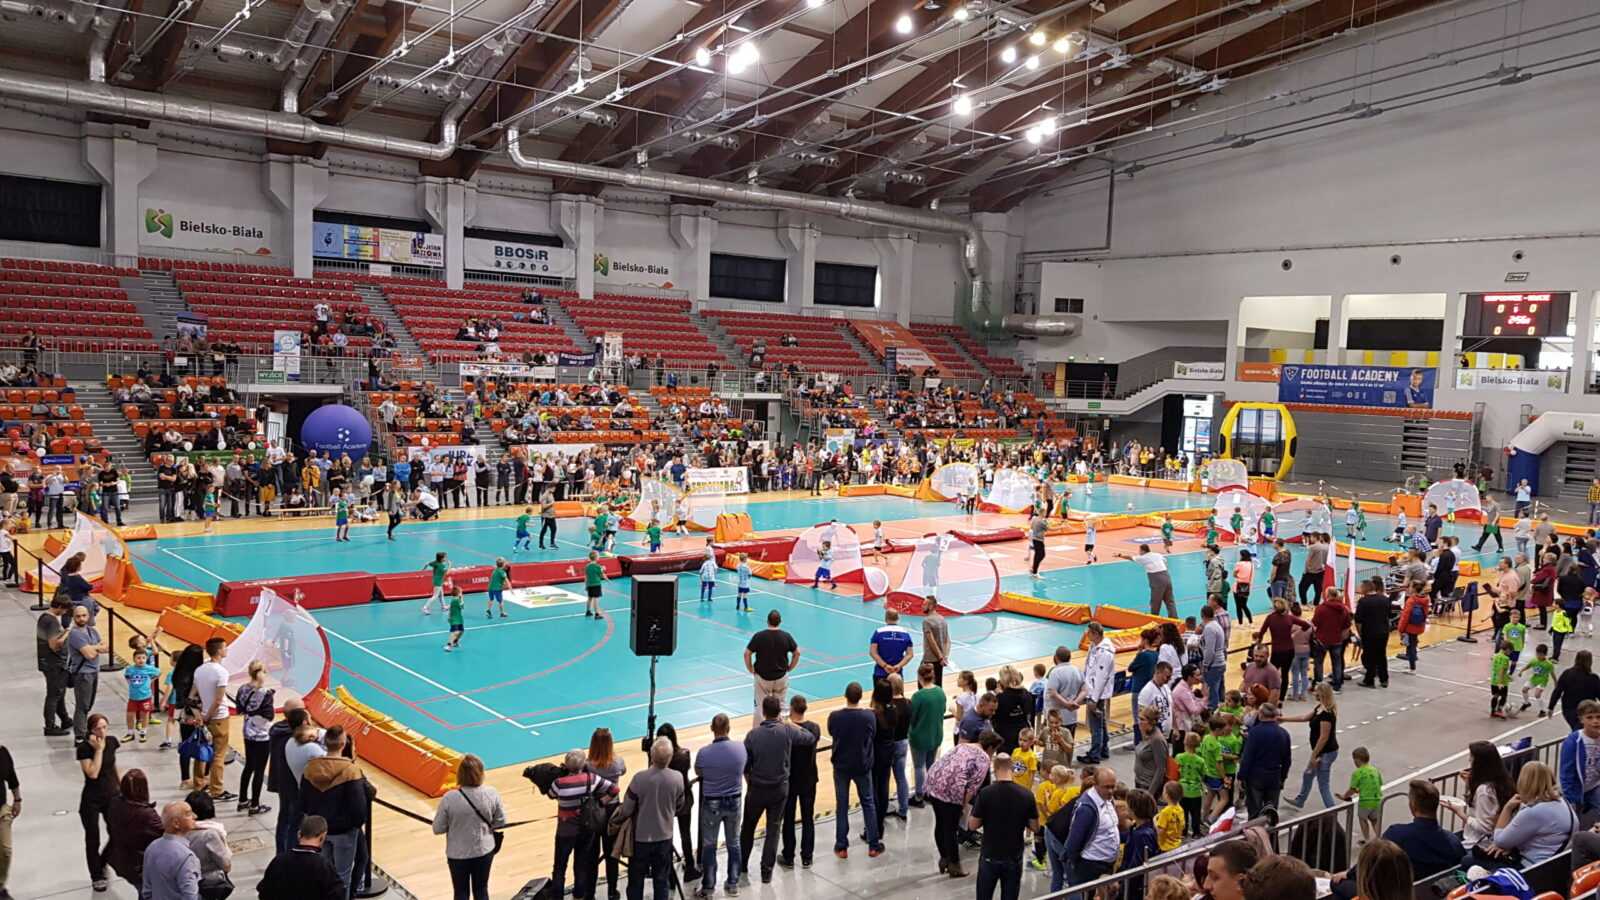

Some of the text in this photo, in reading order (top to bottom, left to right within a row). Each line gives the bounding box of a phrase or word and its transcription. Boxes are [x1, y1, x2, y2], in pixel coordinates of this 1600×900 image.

[180, 220, 264, 239] Bielsko-Biała
[494, 245, 549, 261] BBOSiR
[612, 261, 669, 276] Bielsko-Biała
[1301, 368, 1399, 382] FOOTBALL ACADEMY
[1481, 375, 1540, 386] Bielsko-Biała
